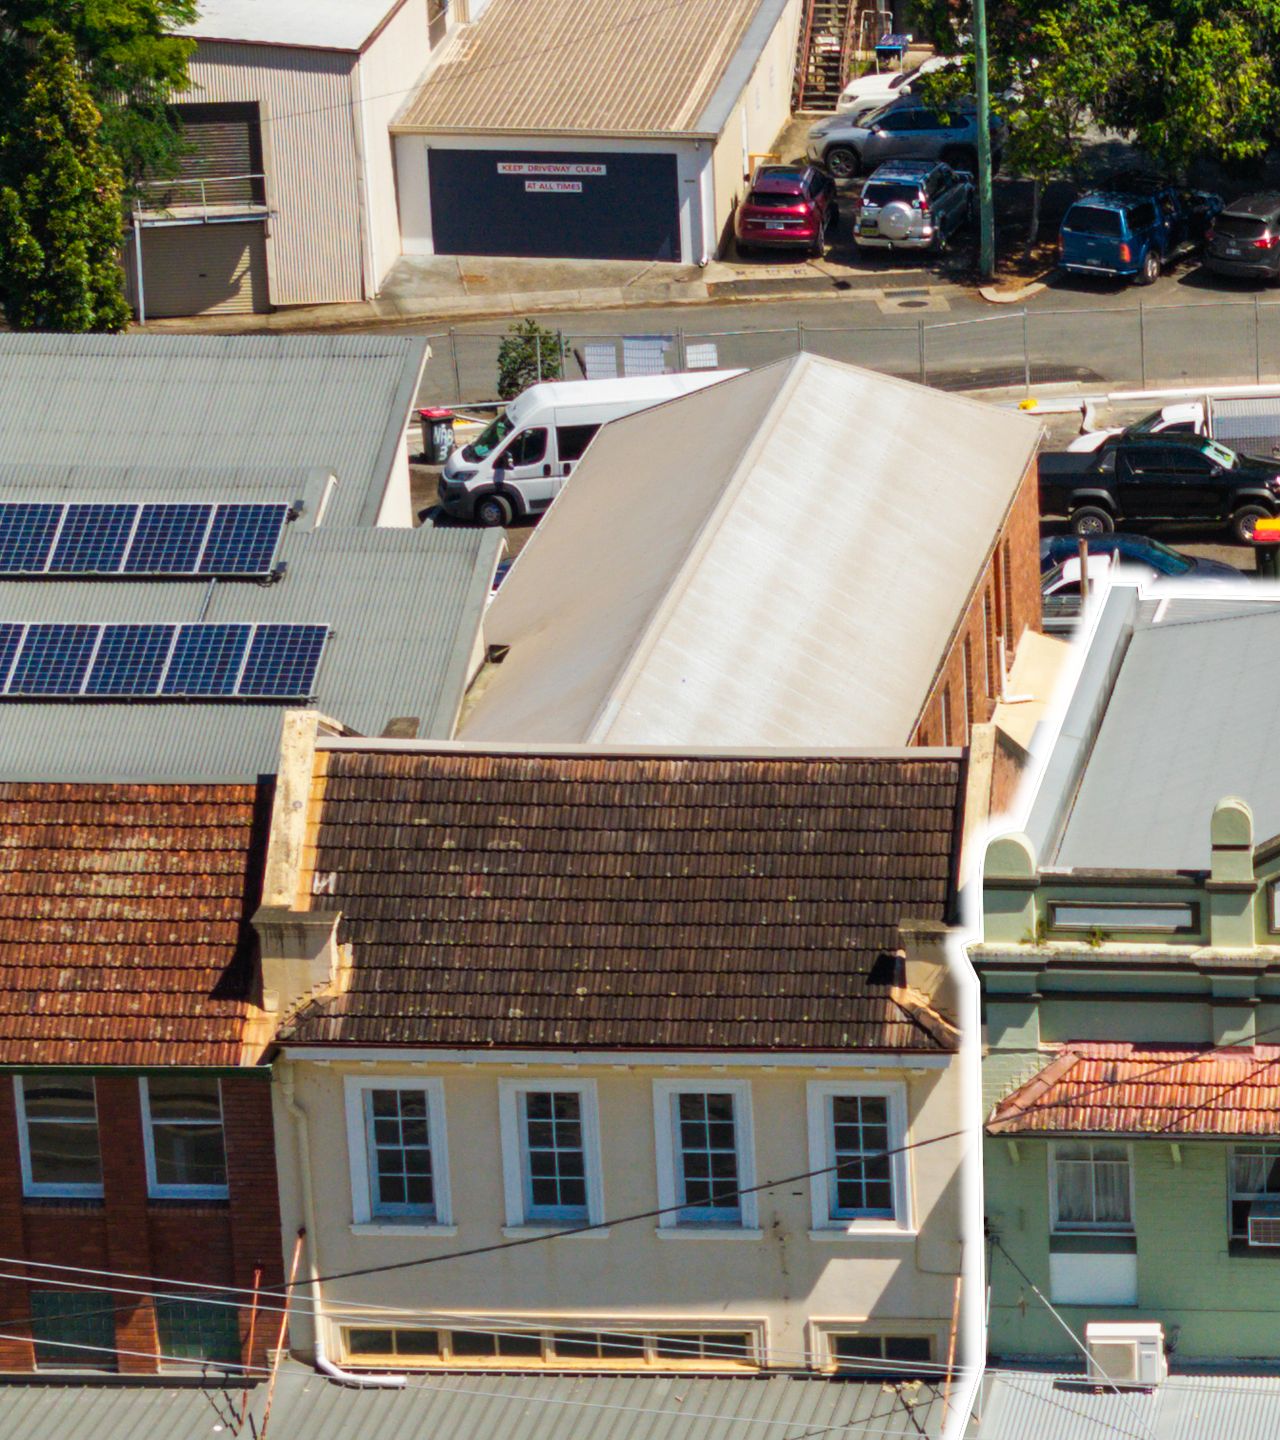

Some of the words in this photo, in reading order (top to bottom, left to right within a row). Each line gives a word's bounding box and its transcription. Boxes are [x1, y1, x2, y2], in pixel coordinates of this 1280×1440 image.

[502, 164, 524, 172] KEEP
[528, 165, 571, 173] DRIVEWAY
[575, 165, 603, 173] CLEAR
[527, 182, 538, 190] AT
[539, 182, 556, 190] ALL
[556, 182, 581, 191] TIMES
[433, 424, 454, 446] NAB
